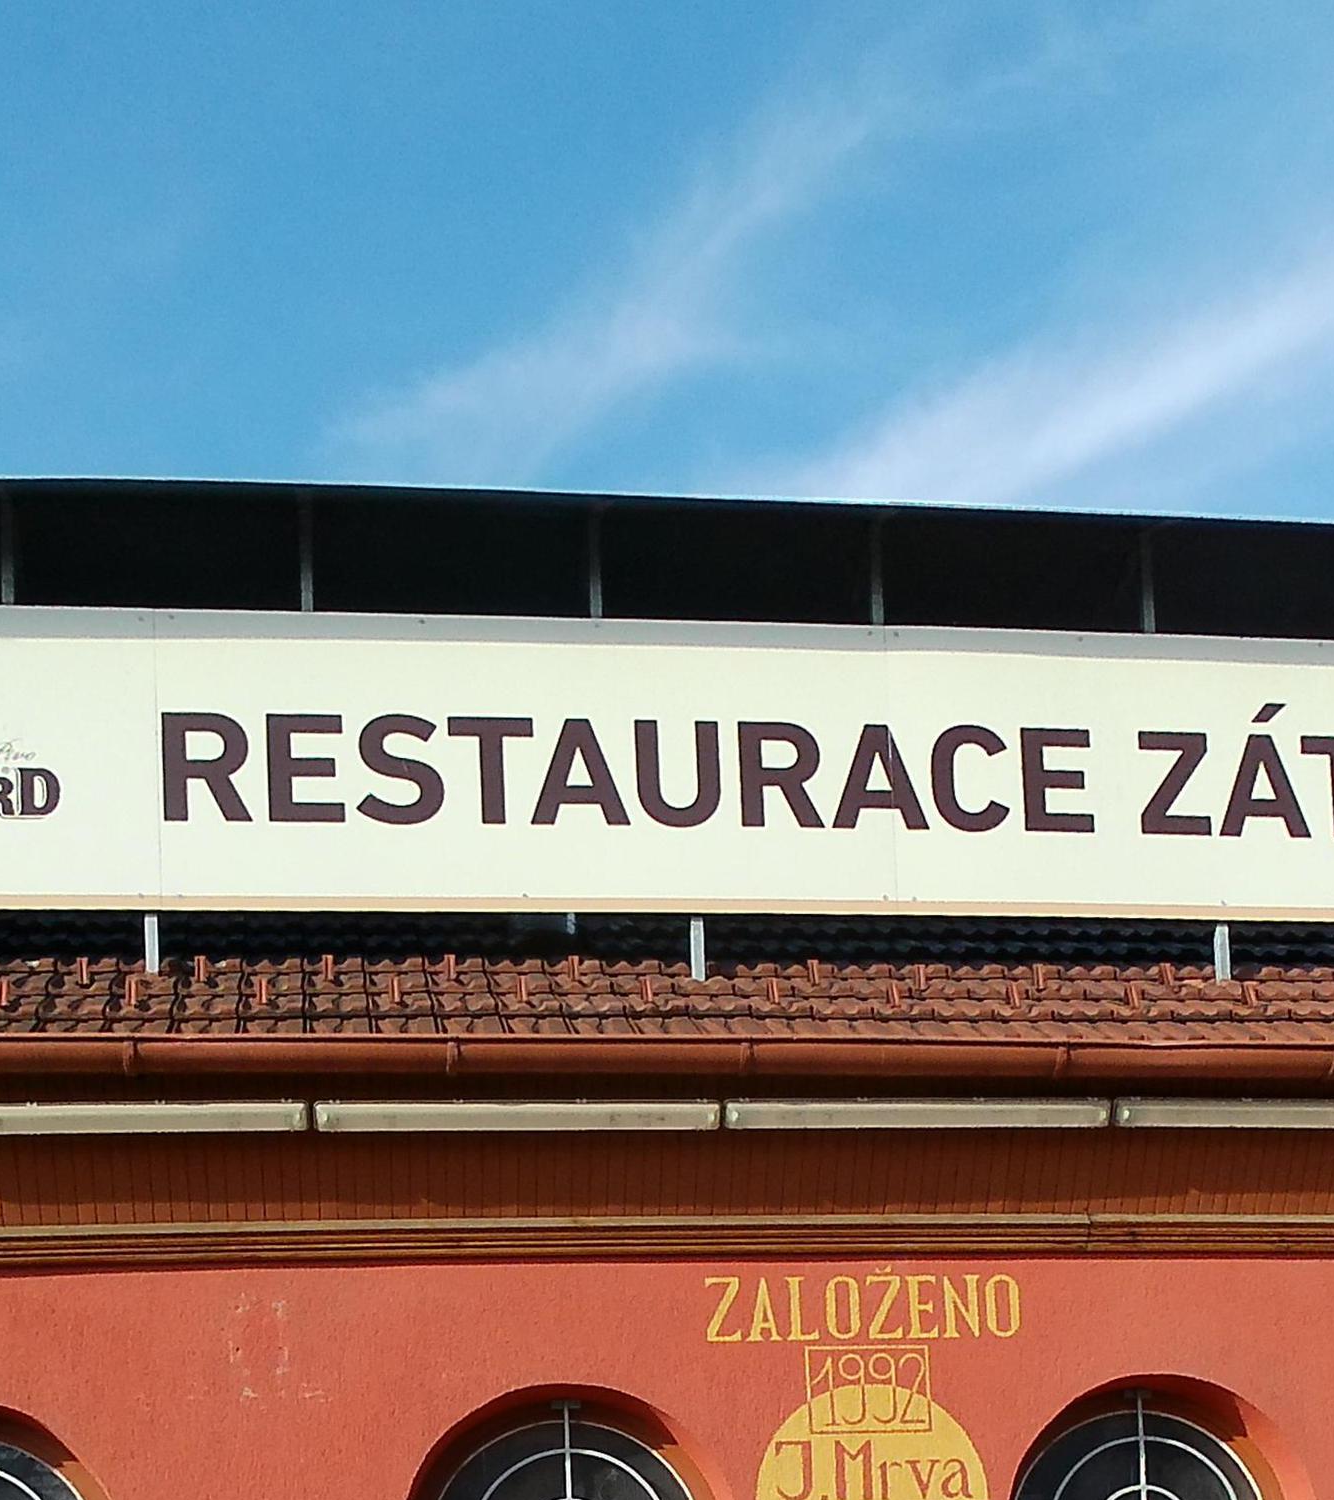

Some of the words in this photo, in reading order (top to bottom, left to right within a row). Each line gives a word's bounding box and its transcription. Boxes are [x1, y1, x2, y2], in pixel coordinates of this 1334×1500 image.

[161, 711, 1096, 835] RESTAURACE
[704, 1266, 1021, 1343] ZALOŽENO
[810, 1352, 927, 1427] 1992
